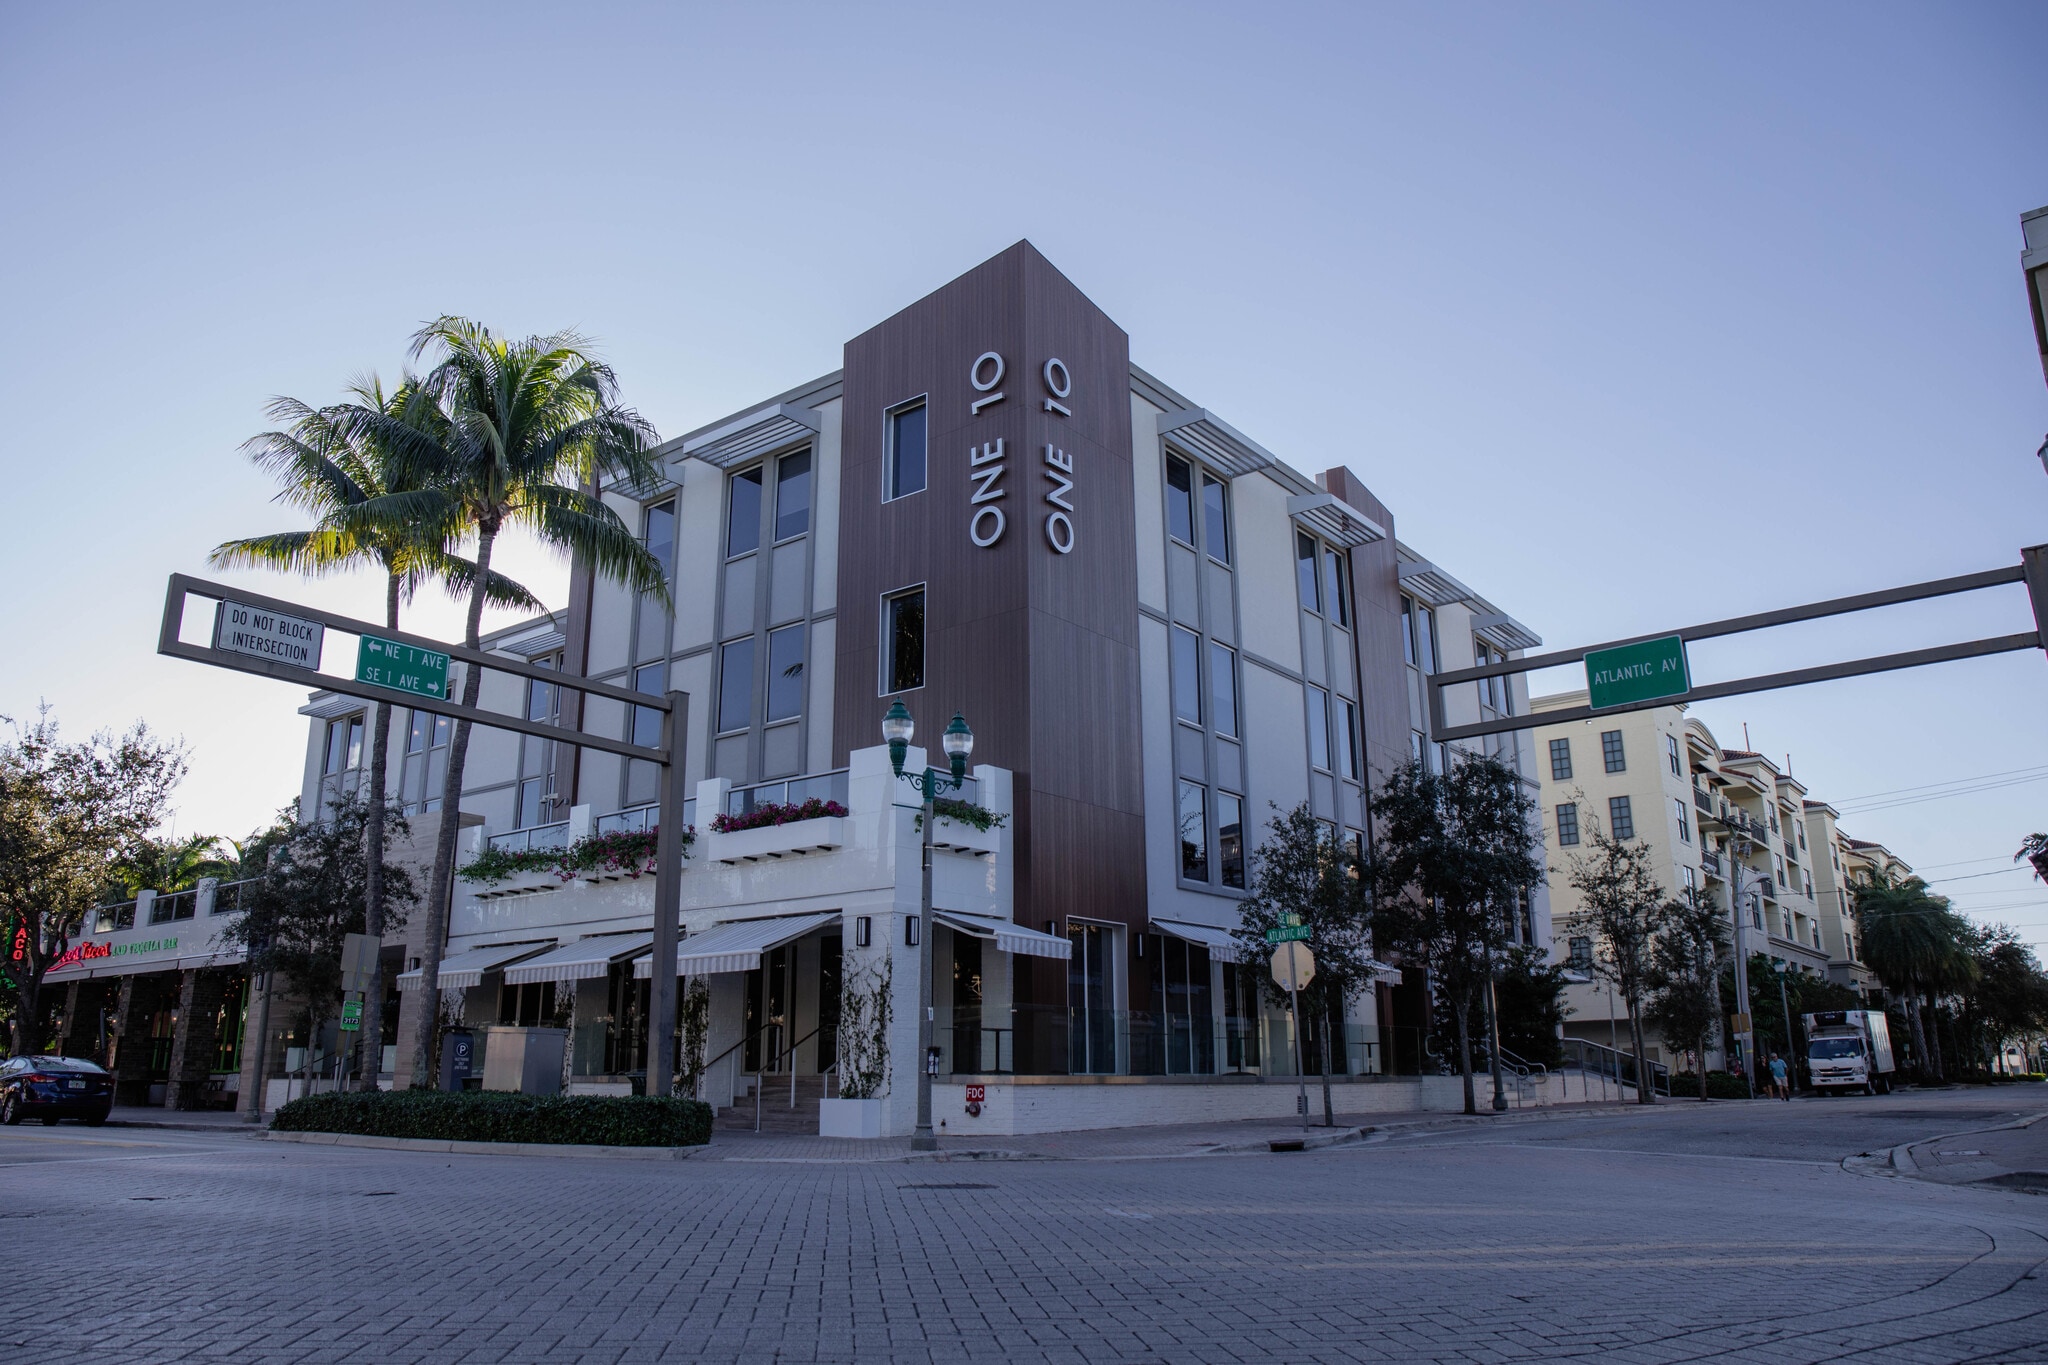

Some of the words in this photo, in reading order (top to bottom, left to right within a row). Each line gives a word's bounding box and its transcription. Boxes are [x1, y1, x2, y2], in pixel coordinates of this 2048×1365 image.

[971, 352, 1006, 416] 10
[1043, 358, 1071, 417] 10
[971, 438, 1006, 547] ONE
[1045, 443, 1074, 554] ONE
[232, 609, 247, 625] DO
[253, 614, 274, 632] NOT
[279, 621, 313, 641] BLOCK
[232, 631, 308, 661] INTERSECTION
[385, 643, 400, 660] NE
[409, 649, 413, 663] 1
[421, 653, 443, 670] AVE
[366, 667, 380, 682] SE
[387, 671, 391, 684] 1
[399, 673, 420, 690] AVE
[1595, 662, 1653, 685] ATLANTIC
[1662, 657, 1677, 672] AV
[13, 917, 27, 960] ACO
[1269, 928, 1295, 941] ATLANTIC
[1297, 926, 1309, 938] AVE
[966, 1087, 983, 1098] FDC
